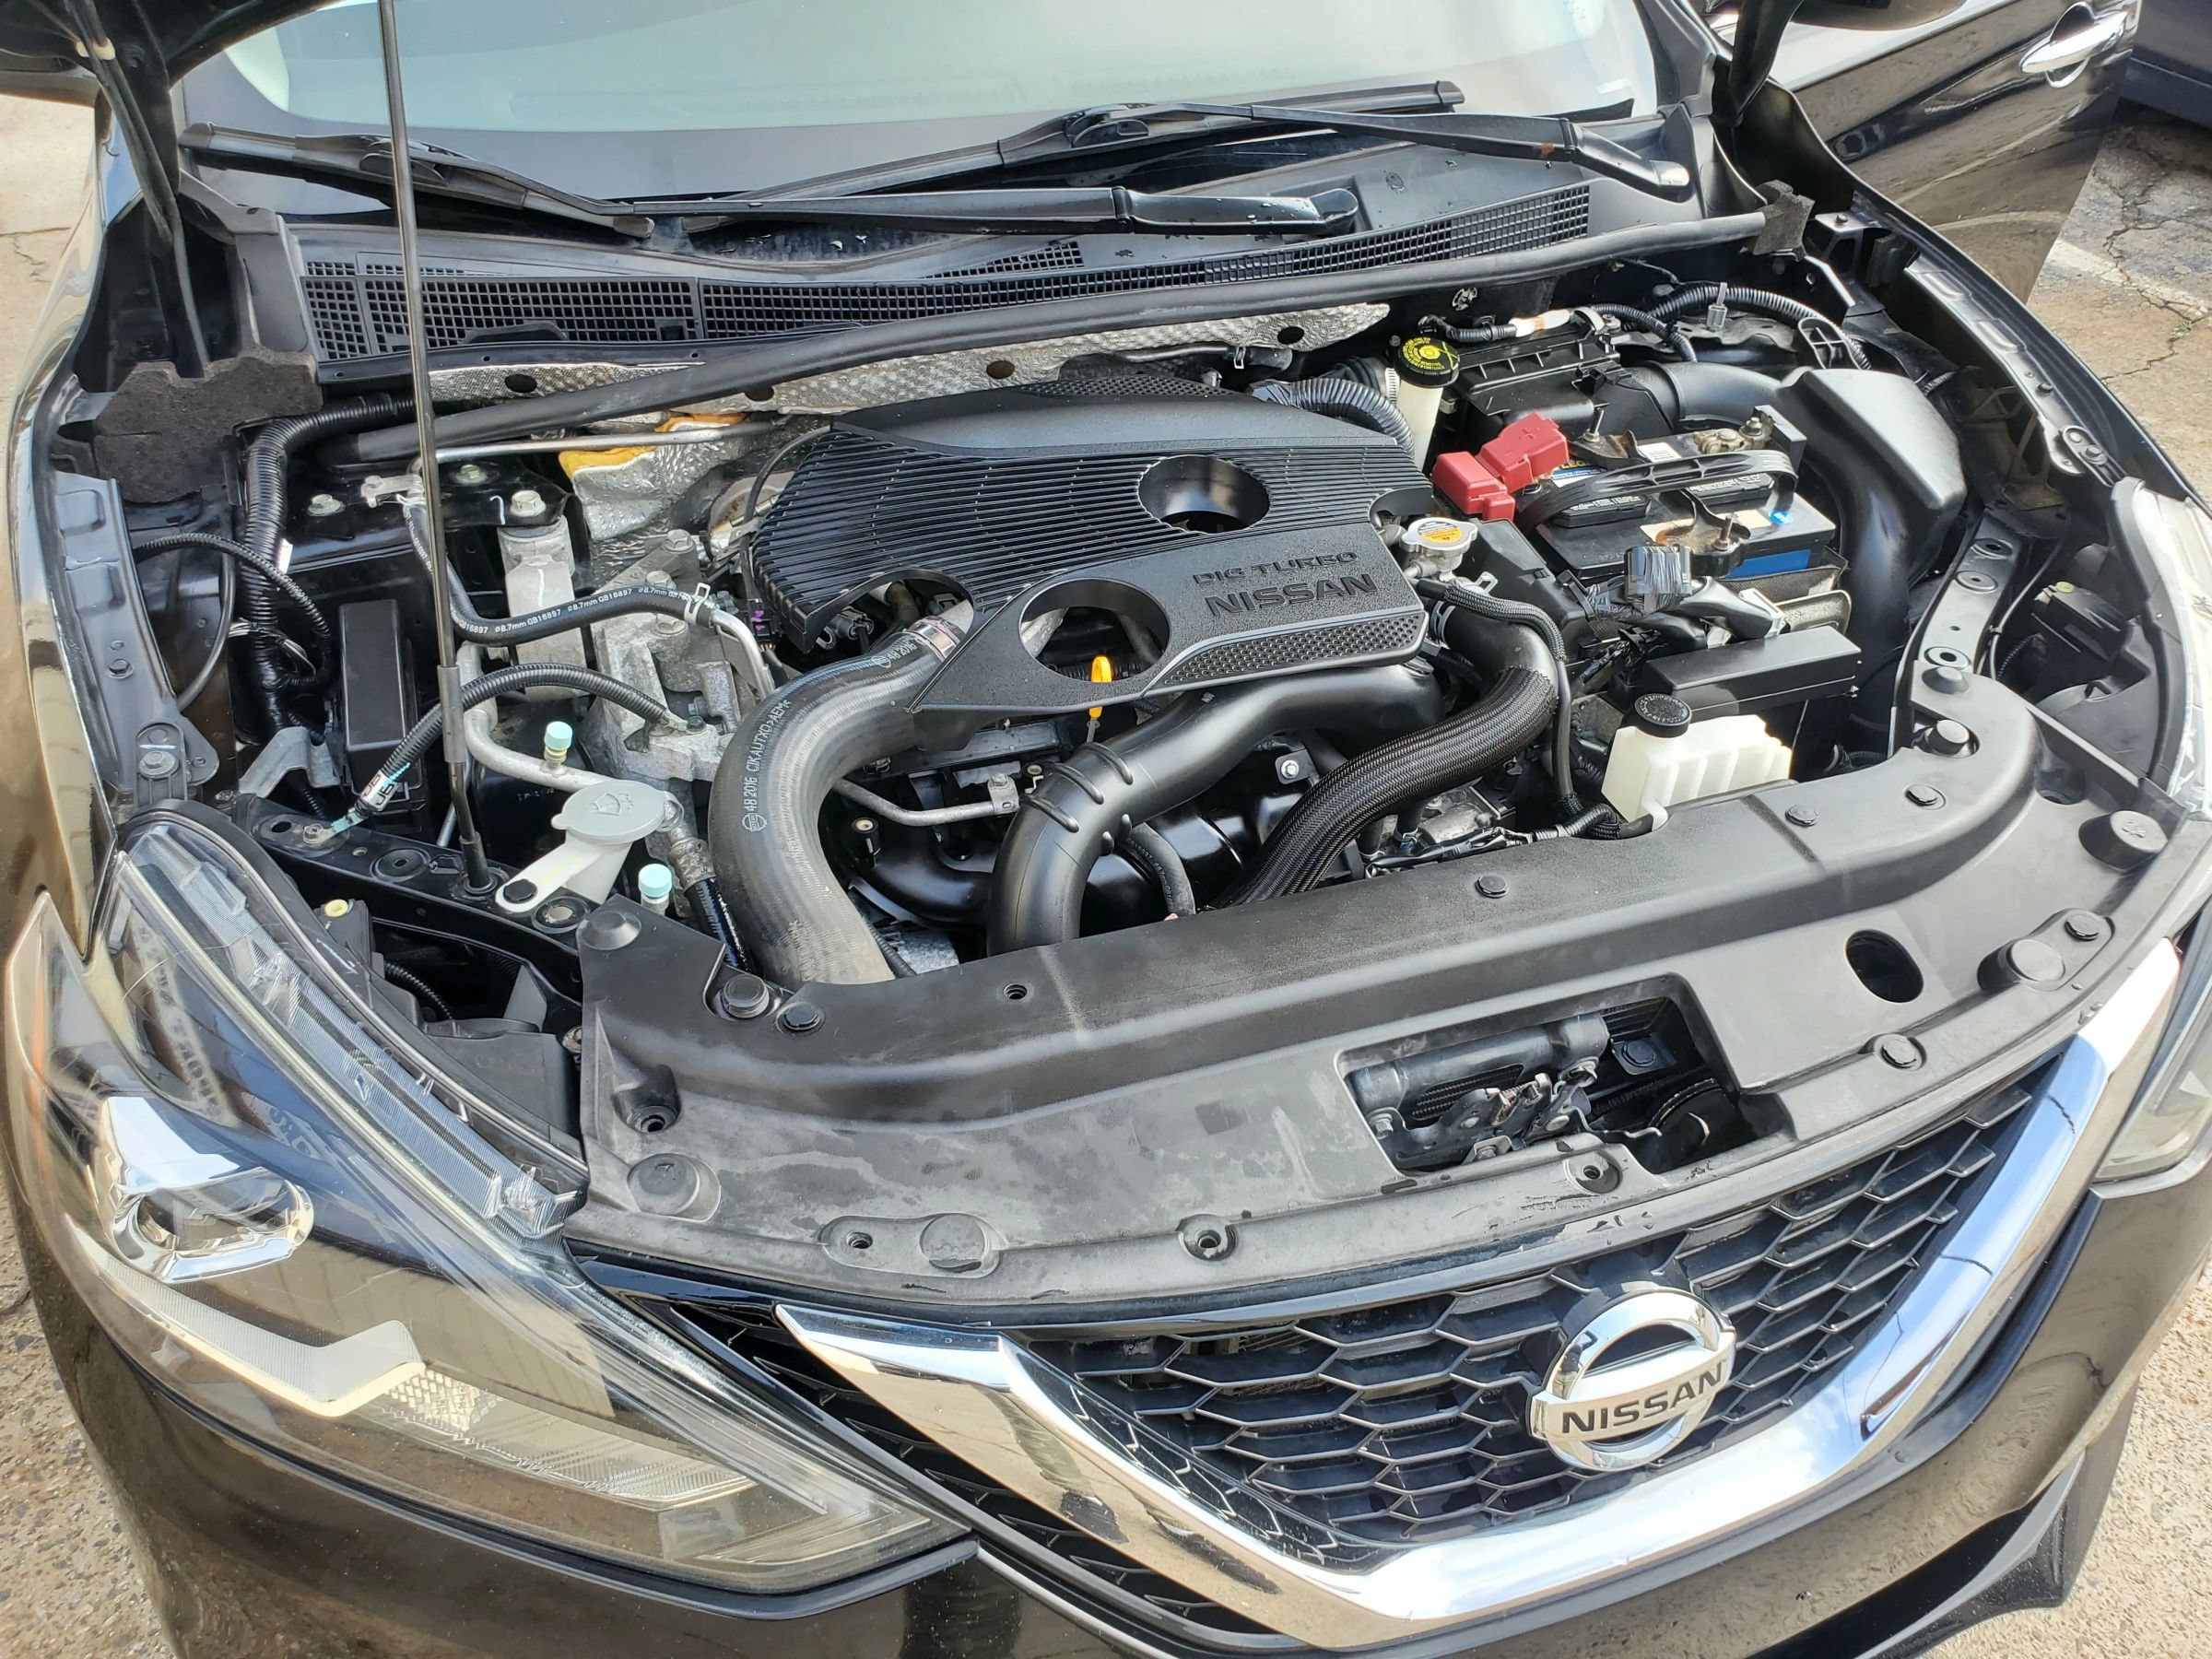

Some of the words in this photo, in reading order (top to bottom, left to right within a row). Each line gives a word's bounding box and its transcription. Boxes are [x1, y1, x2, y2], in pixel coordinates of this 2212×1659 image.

[1193, 567, 1245, 585] DIG
[1252, 551, 1358, 574] TURBO
[527, 608, 561, 625] GB16897
[598, 588, 632, 603] GB16897
[1205, 573, 1379, 617] NISSAN
[743, 776, 758, 798] 2016
[743, 798, 758, 812] 48
[1562, 1361, 1724, 1434] NISSAN
